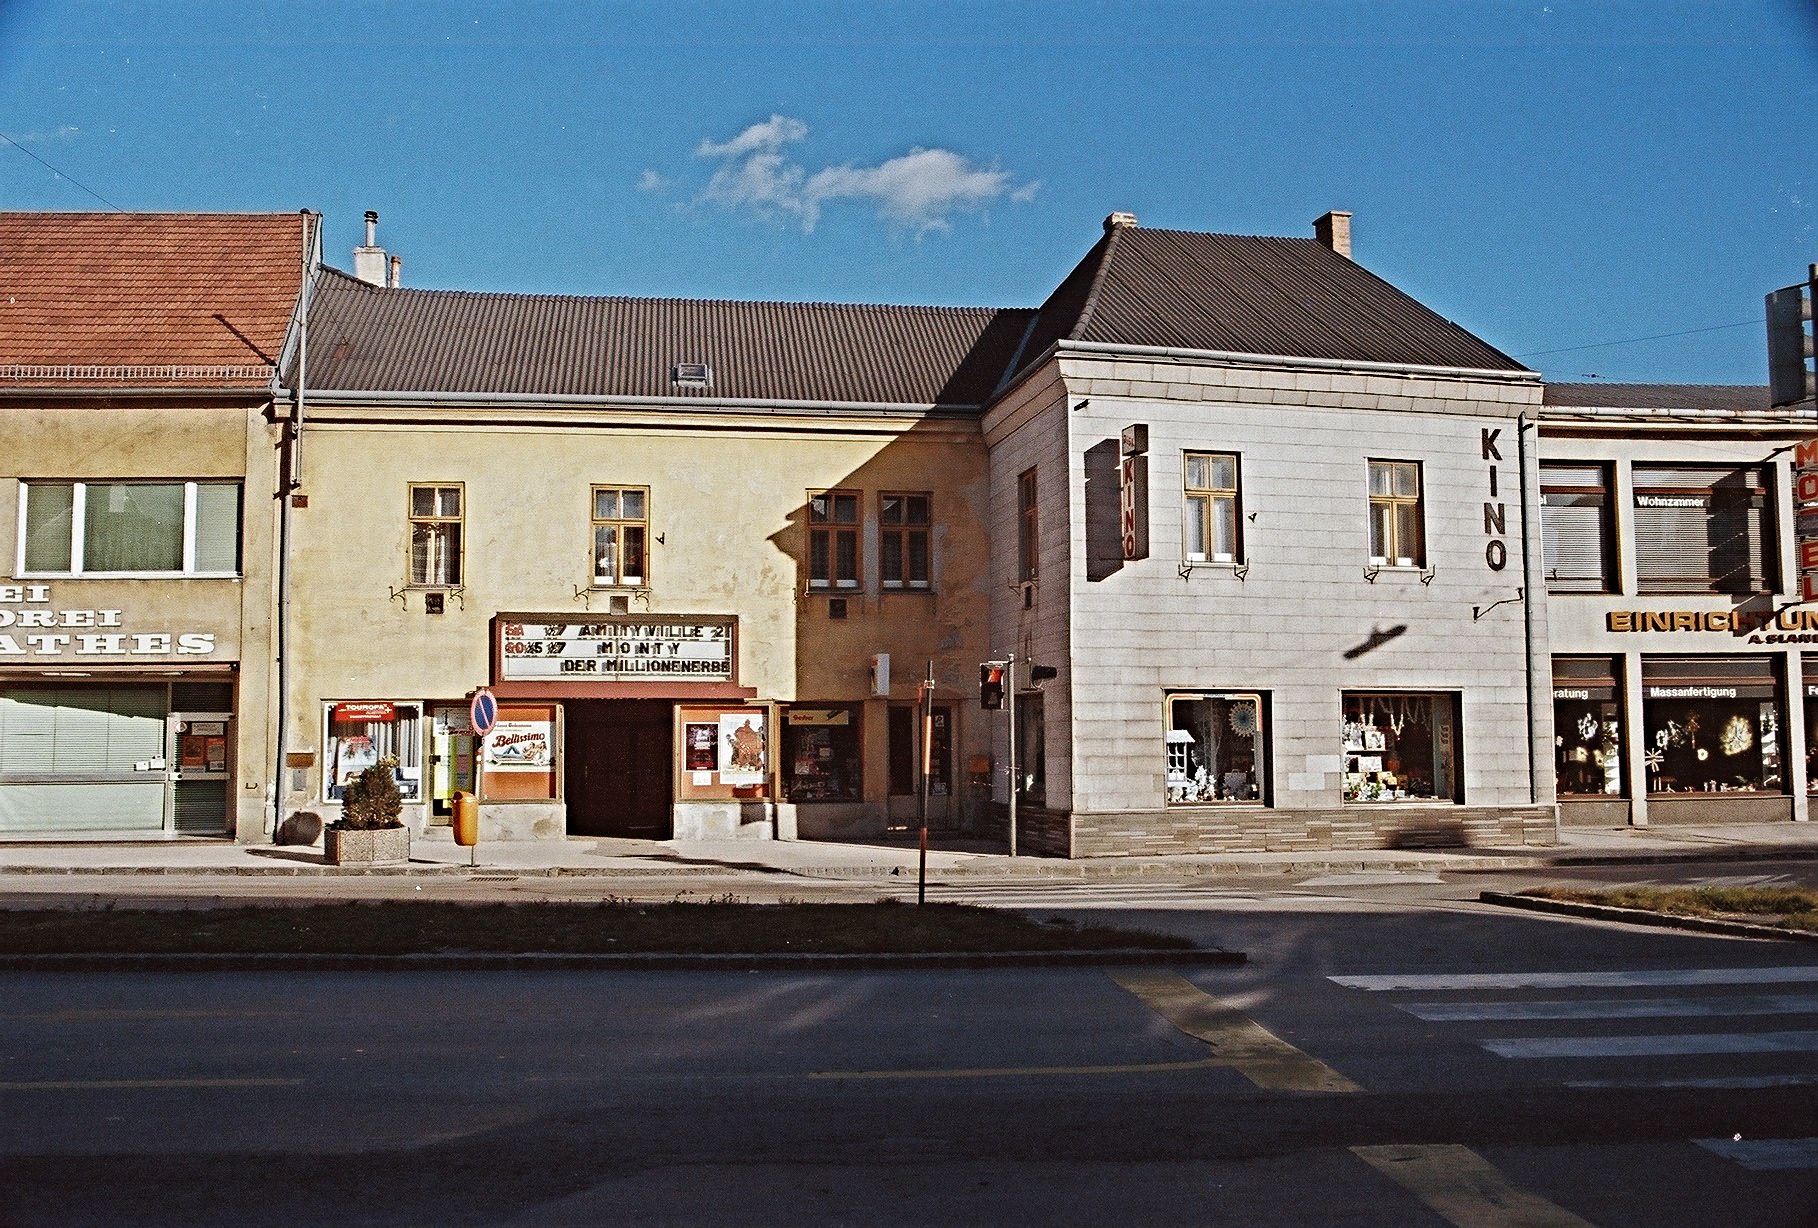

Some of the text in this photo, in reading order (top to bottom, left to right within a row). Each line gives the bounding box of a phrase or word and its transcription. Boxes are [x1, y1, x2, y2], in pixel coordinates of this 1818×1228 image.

[1482, 428, 1506, 571] KINO
[1125, 459, 1135, 557] KINO
[599, 642, 680, 654] MONTY
[562, 659, 730, 673] DER MILLIONENERBE
[1552, 688, 1589, 700] ratung
[1650, 686, 1737, 698] Massanfertigung
[491, 732, 546, 748] Bellissimo
